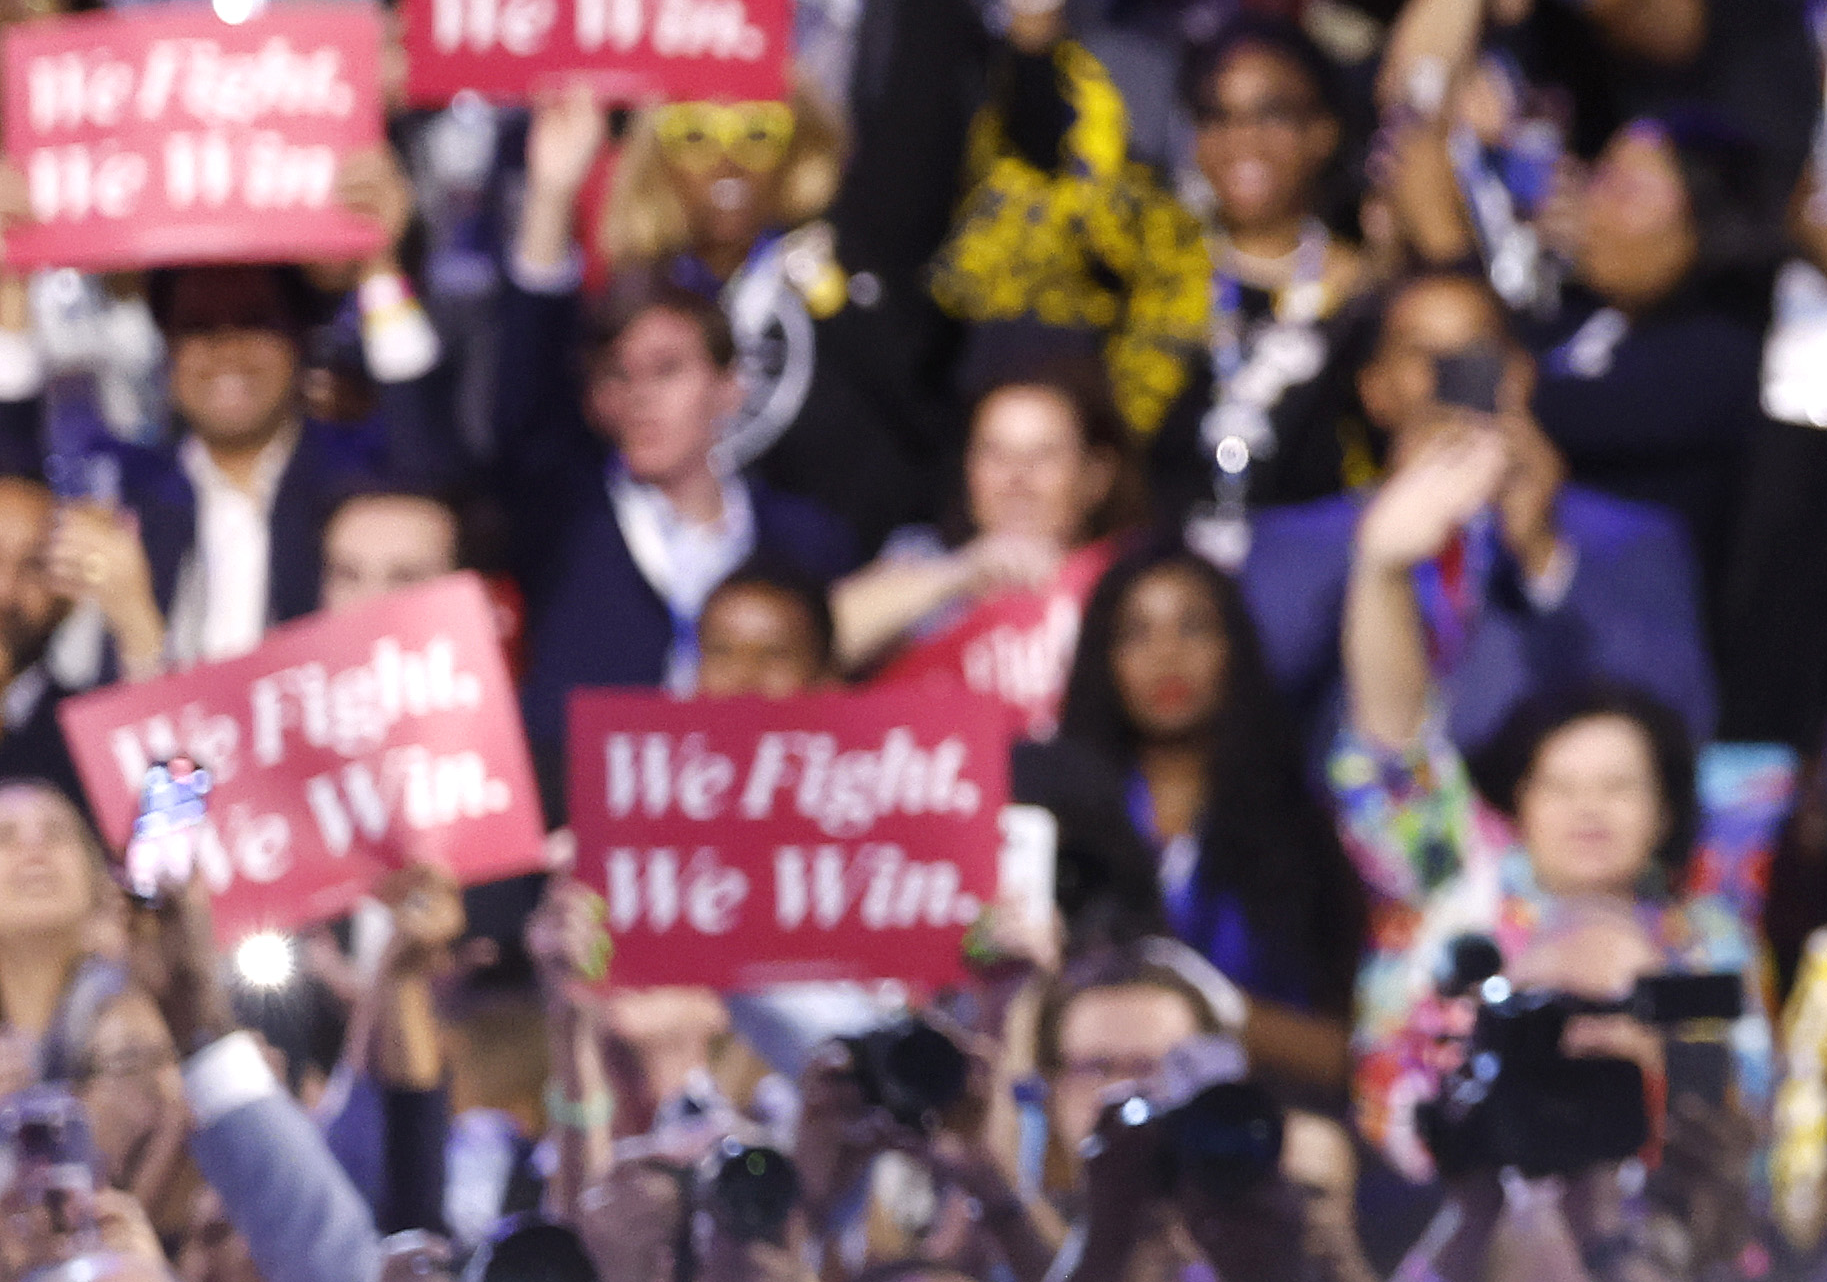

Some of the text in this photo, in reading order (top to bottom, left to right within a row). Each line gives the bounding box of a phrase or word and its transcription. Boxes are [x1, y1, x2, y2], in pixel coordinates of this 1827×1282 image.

[25, 37, 354, 129] We Fight.
[27, 139, 149, 221] We
[248, 634, 482, 767] Fight.
[306, 743, 512, 859] Win.
[604, 725, 983, 840] We Fight.
[605, 841, 983, 936] We Win.
